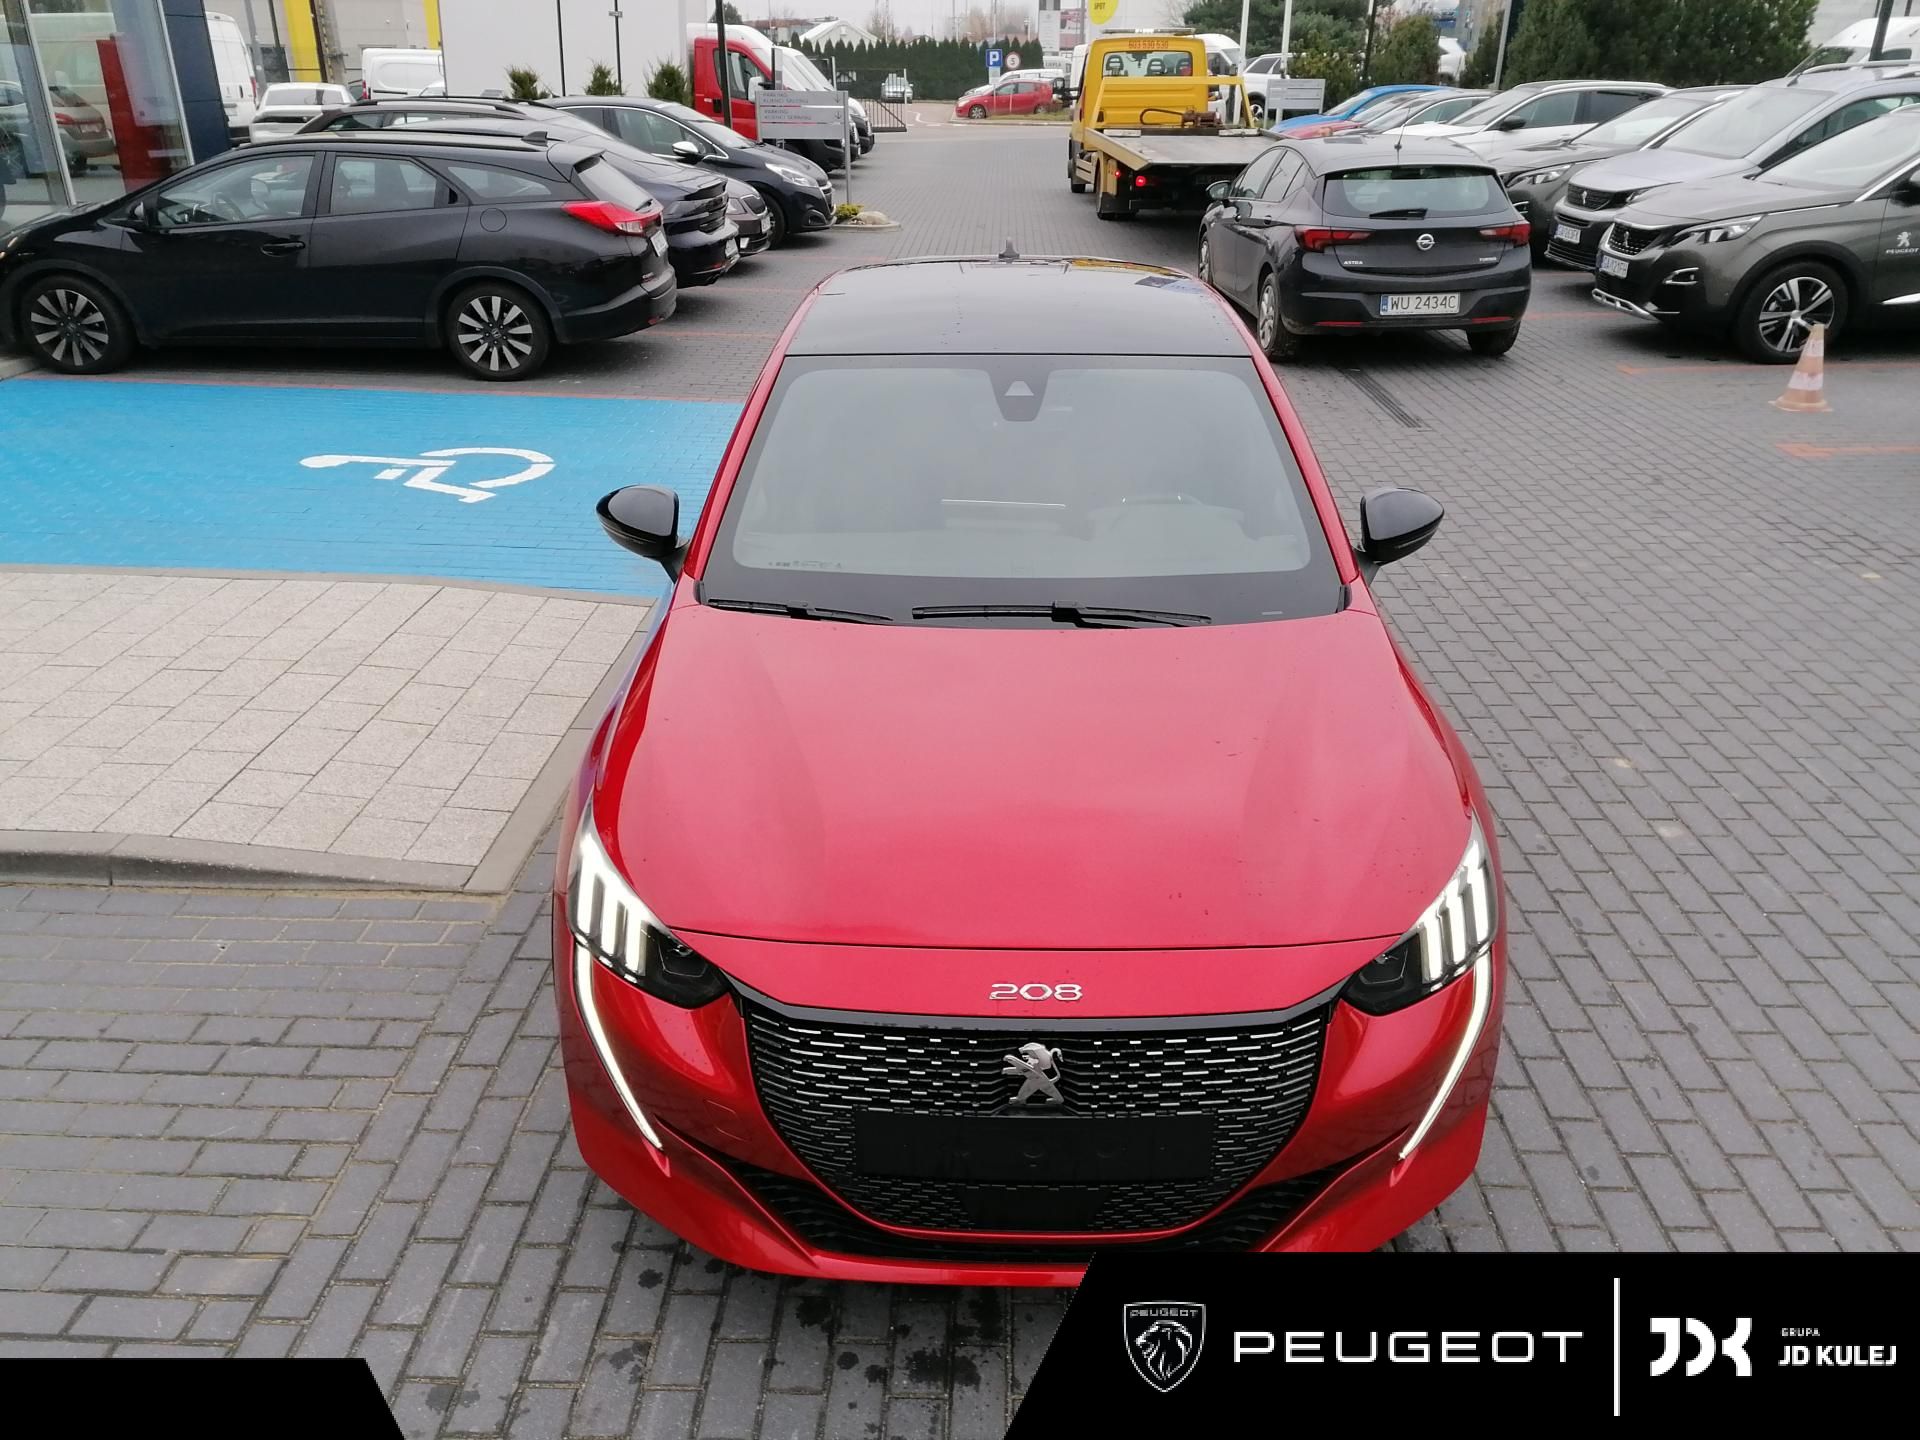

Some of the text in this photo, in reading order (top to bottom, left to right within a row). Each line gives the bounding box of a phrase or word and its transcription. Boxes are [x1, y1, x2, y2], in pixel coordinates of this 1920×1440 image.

[989, 51, 1000, 66] P
[1390, 295, 1458, 311] WU 2434C
[989, 983, 1083, 1001] 208
